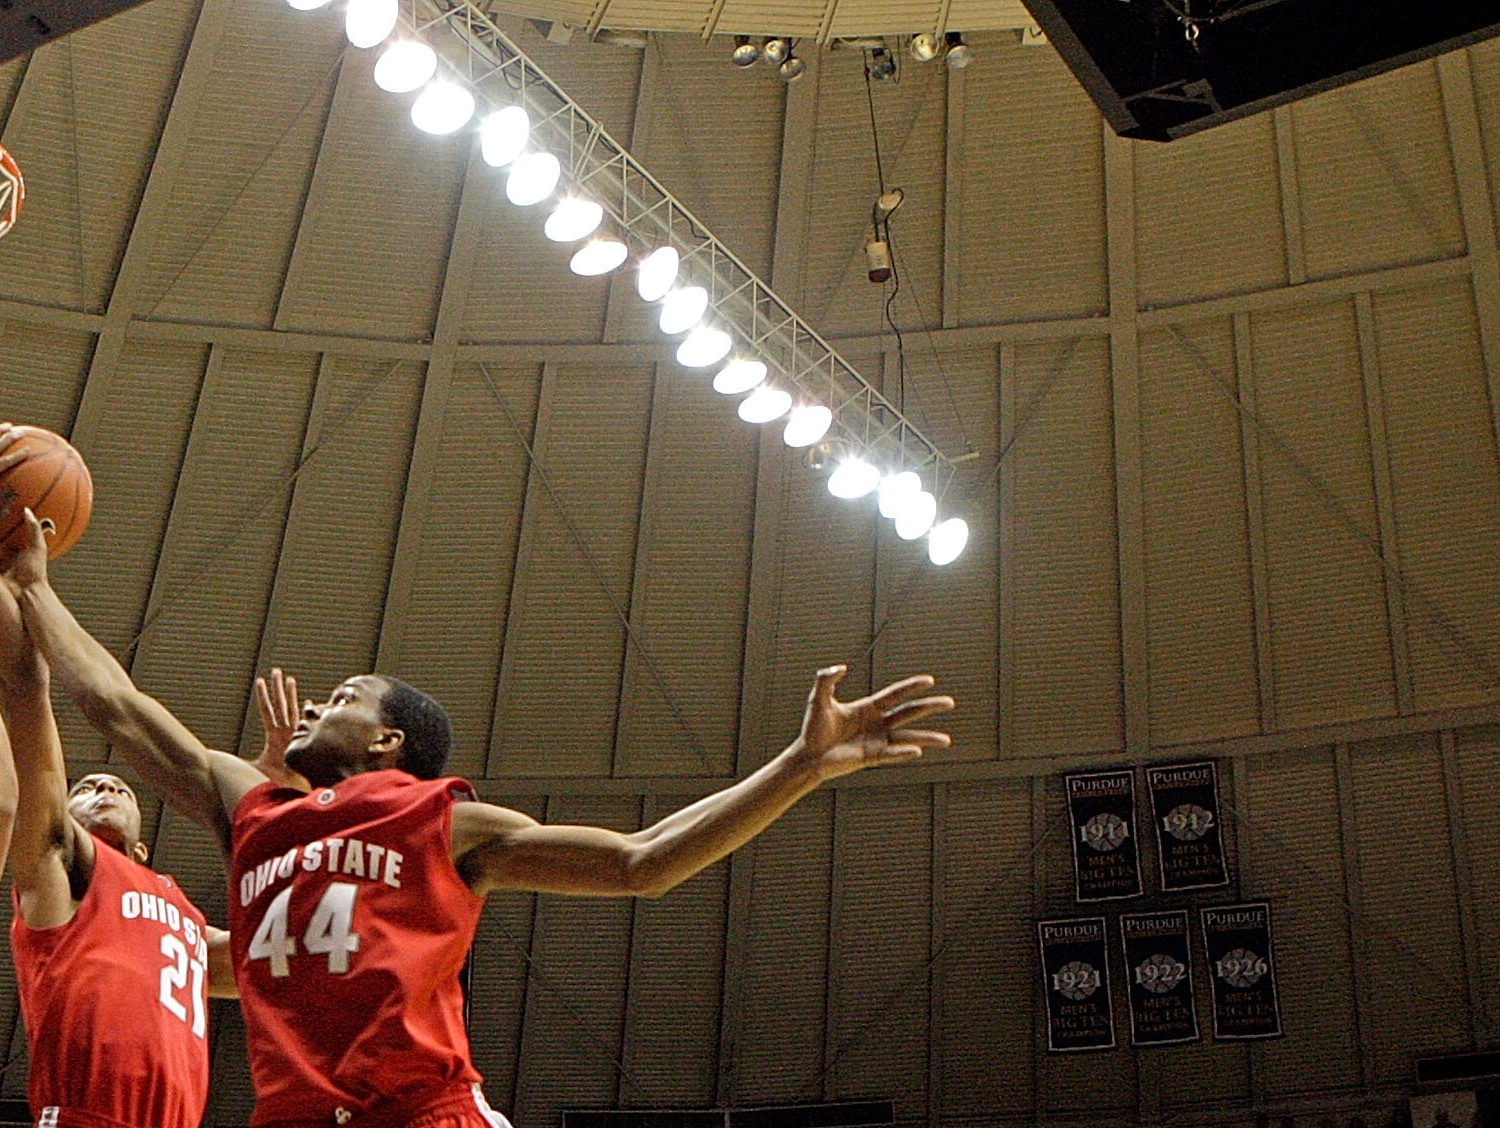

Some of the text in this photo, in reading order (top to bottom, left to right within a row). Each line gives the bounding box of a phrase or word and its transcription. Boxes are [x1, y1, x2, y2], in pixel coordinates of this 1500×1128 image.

[1072, 777, 1129, 792] PURDUE
[1153, 769, 1210, 785] PURDUE
[1080, 820, 1130, 842] 1911
[1162, 810, 1216, 833] 1912
[240, 838, 404, 907] OHIO STATE
[121, 891, 181, 932] OHIO
[1207, 910, 1265, 925] PURDUE
[250, 881, 360, 978] 44
[1044, 924, 1102, 939] PURDUE
[1126, 917, 1183, 933] PURDUE
[1135, 963, 1187, 984] 1922
[1216, 957, 1268, 979] 1926
[160, 933, 207, 1040] 21
[1052, 970, 1101, 990] 1921
